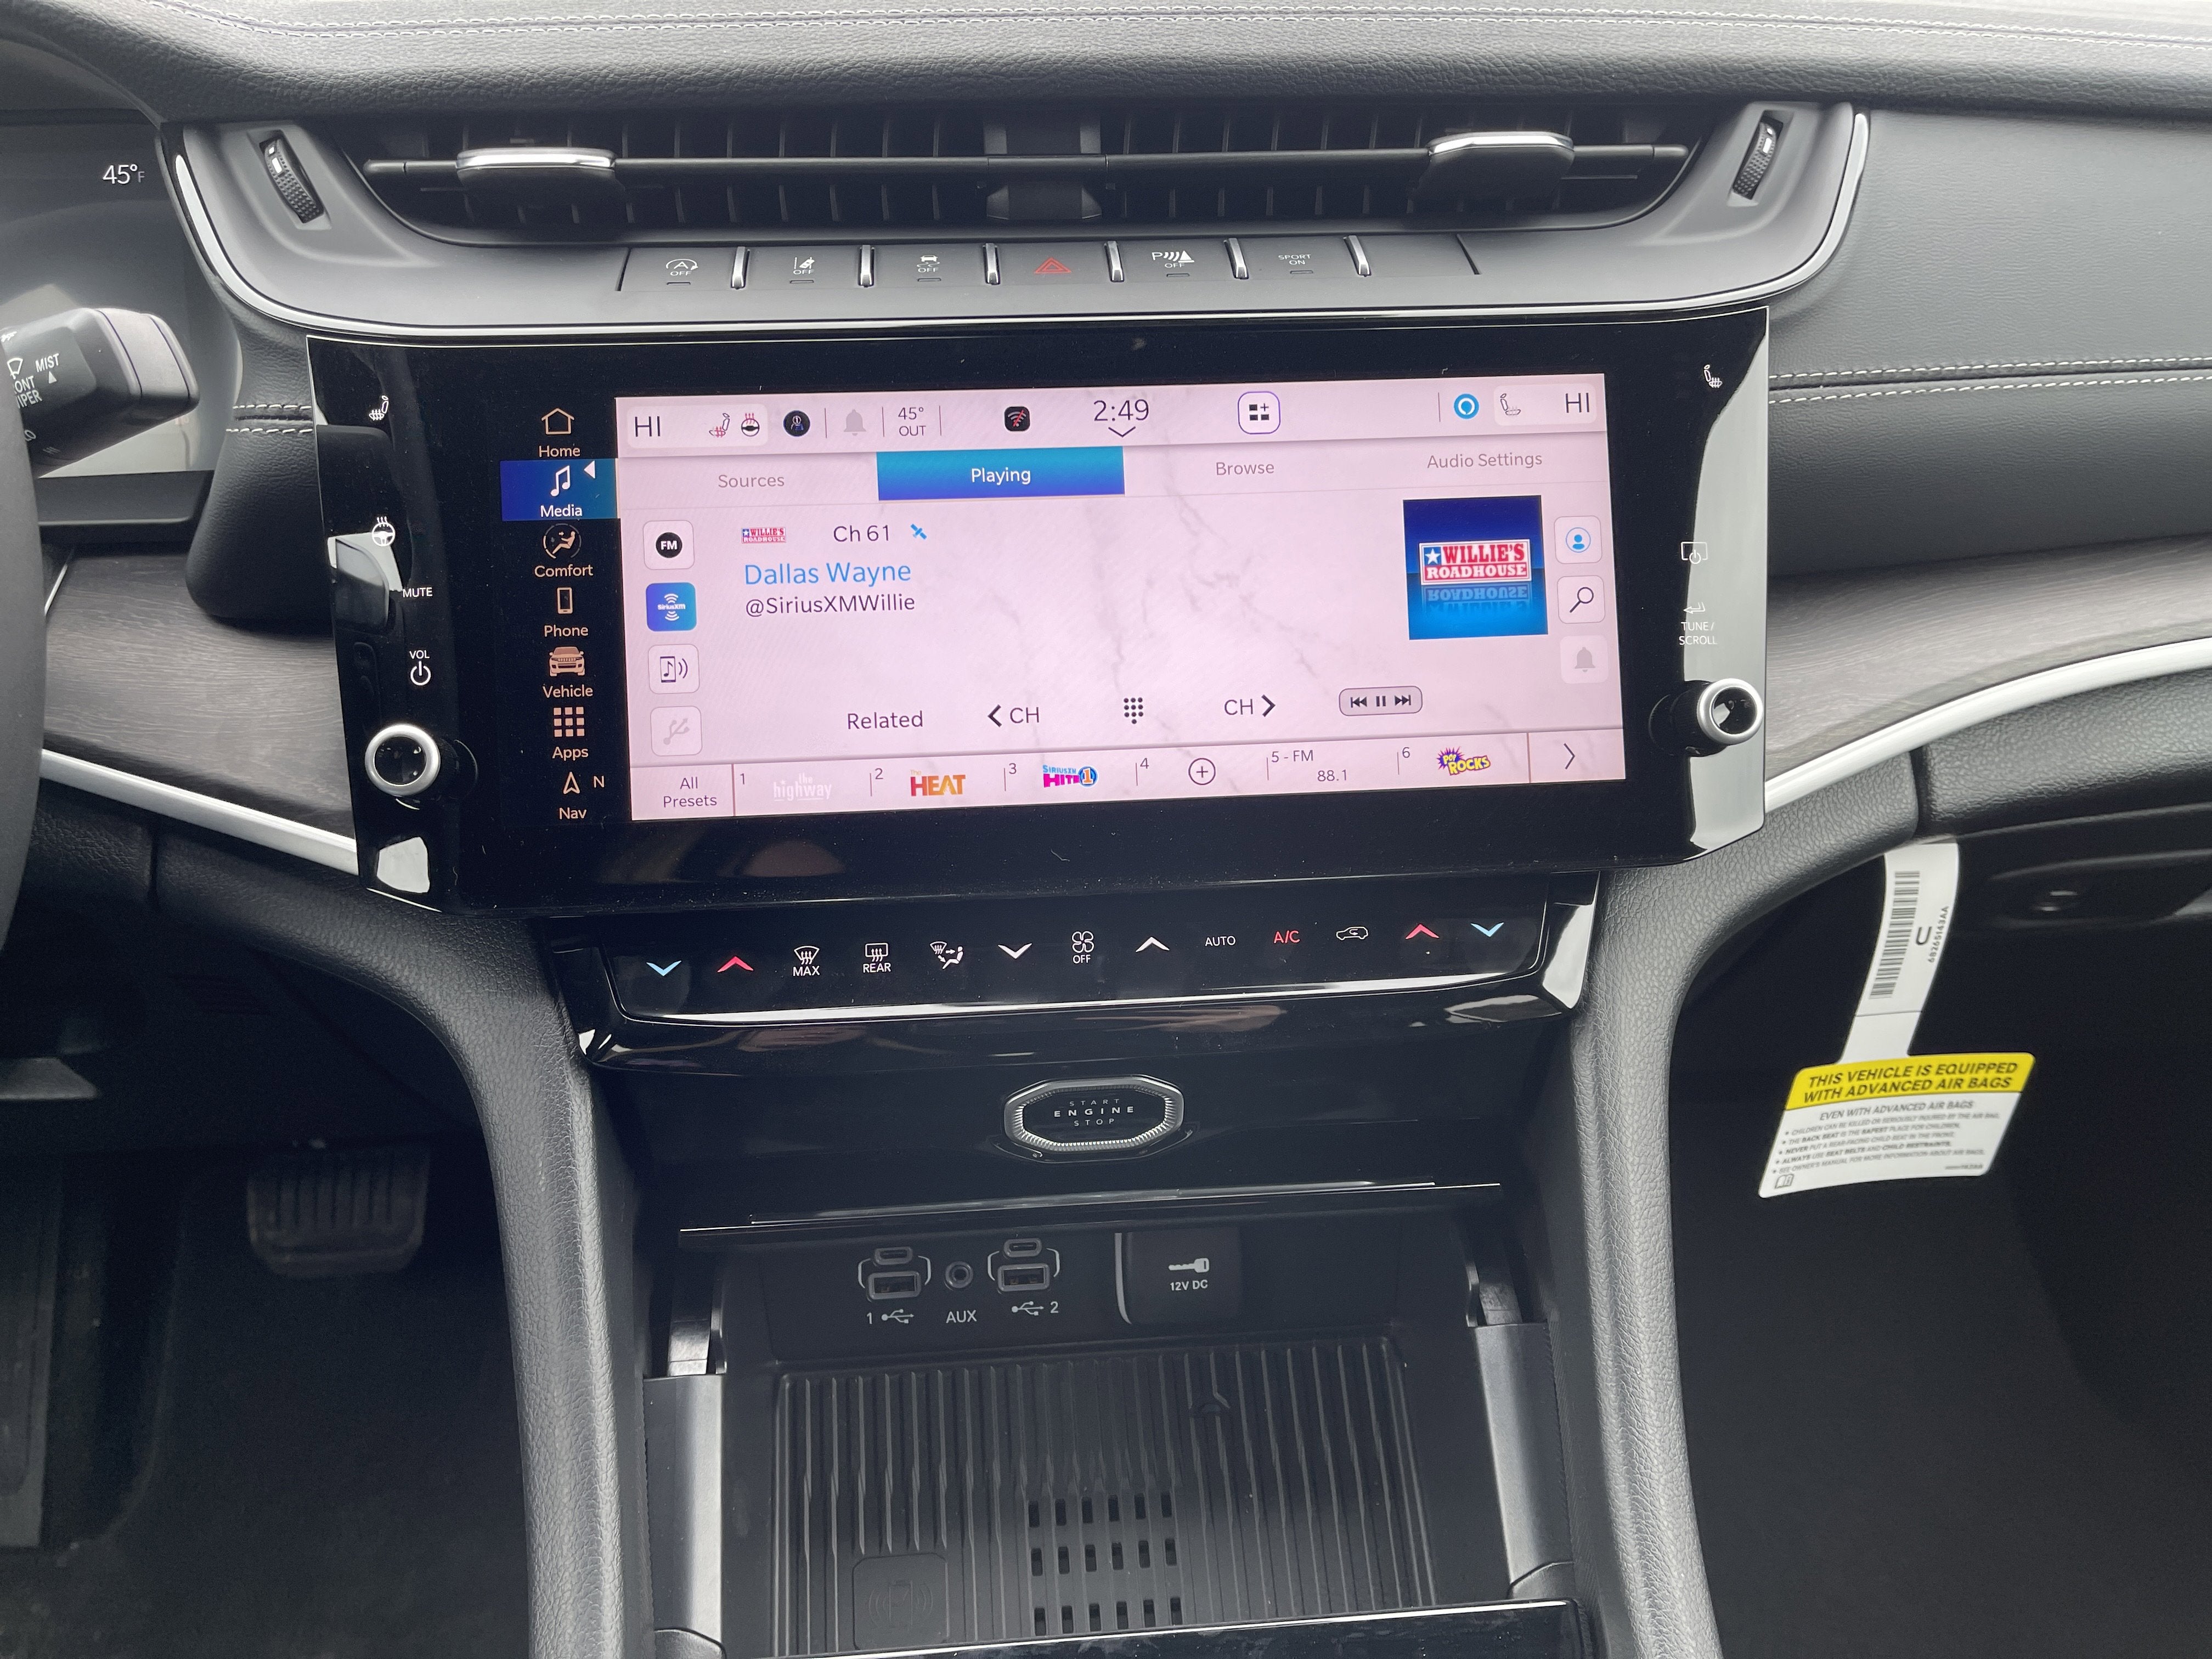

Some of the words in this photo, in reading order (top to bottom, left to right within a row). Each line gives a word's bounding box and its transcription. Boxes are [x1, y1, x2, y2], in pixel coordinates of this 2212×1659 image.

[35, 353, 59, 373] MIST
[14, 376, 35, 394] ONT
[1565, 392, 1590, 414] HI
[898, 407, 924, 420] 45°
[1093, 398, 1150, 422] 2:49
[634, 415, 661, 437] HI
[899, 425, 927, 436] OUT
[538, 445, 580, 458] Home
[1427, 453, 1474, 469] Audio
[1478, 452, 1543, 470] Settings
[1216, 460, 1275, 476] Browse
[718, 474, 785, 489] Sources
[970, 467, 1032, 485] Playing
[540, 505, 583, 517] Media
[750, 528, 784, 536] WILLIE'S
[833, 525, 861, 543] Ch
[866, 524, 889, 541] 61
[661, 540, 678, 550] FM
[1442, 543, 1525, 563] WILLIE'S
[534, 564, 594, 577] Comfort
[745, 563, 819, 585] Dallas
[826, 562, 911, 587] Wayne
[1426, 563, 1527, 579] ROADHOUSE
[402, 587, 433, 598] MUTE
[745, 593, 916, 618] @SiriusXMWillie
[544, 624, 589, 637] Phone
[1680, 622, 1714, 631] TUNE/
[1679, 635, 1718, 646] SCROLL
[409, 650, 430, 659] VOL
[543, 684, 594, 698] Vehicle
[1224, 698, 1254, 716] CH
[847, 710, 924, 730] Related
[1010, 707, 1040, 724] CH
[552, 746, 589, 761] Apps
[1271, 751, 1279, 763] 5
[1293, 750, 1314, 762] FM
[1402, 747, 1410, 758] 6
[1008, 763, 1017, 775] 3
[1140, 758, 1150, 770] 4
[1448, 757, 1490, 774] ROCKS
[740, 772, 746, 785] 1
[799, 772, 813, 784] the
[875, 768, 884, 780] 2
[1082, 768, 1093, 785] 1
[1317, 770, 1347, 782] 88.1
[593, 775, 605, 788] N
[680, 776, 698, 790] All
[910, 775, 966, 797] HEAT
[773, 780, 832, 802] highway
[663, 794, 718, 809] Presets
[559, 807, 587, 820] Nav
[1205, 936, 1236, 947] AUTO
[1273, 930, 1300, 944] A/C
[1073, 955, 1091, 964] OFF
[793, 966, 820, 977] MAX
[862, 963, 891, 973] REAR
[1810, 1073, 1843, 1088] THIS
[1848, 1066, 1913, 1082] VEHICLE
[1916, 1065, 1932, 1076] IS
[1936, 1063, 2018, 1075] EQUIPPED
[1804, 1087, 1843, 1103] WITH
[1846, 1080, 1932, 1097] ADVANCED
[1936, 1079, 1963, 1090] AIR
[1968, 1077, 2012, 1088] BAGS
[1070, 1098, 1120, 1107] START
[1054, 1106, 1134, 1118] ENGINE
[1820, 1110, 1844, 1121] EVEN
[1847, 1107, 1871, 1116] WITH
[1874, 1103, 1926, 1113] ADVANCED
[1947, 1100, 1974, 1109] BAGS
[1074, 1118, 1115, 1127] STOP
[1792, 1126, 1822, 1136] CHILDREN
[1782, 1155, 1810, 1164] ALWAYS
[1170, 1281, 1189, 1291] 12V
[1192, 1279, 1208, 1290] DC
[1050, 1301, 1059, 1313] 2
[866, 1312, 873, 1324] 1
[946, 1310, 978, 1324] AUX
